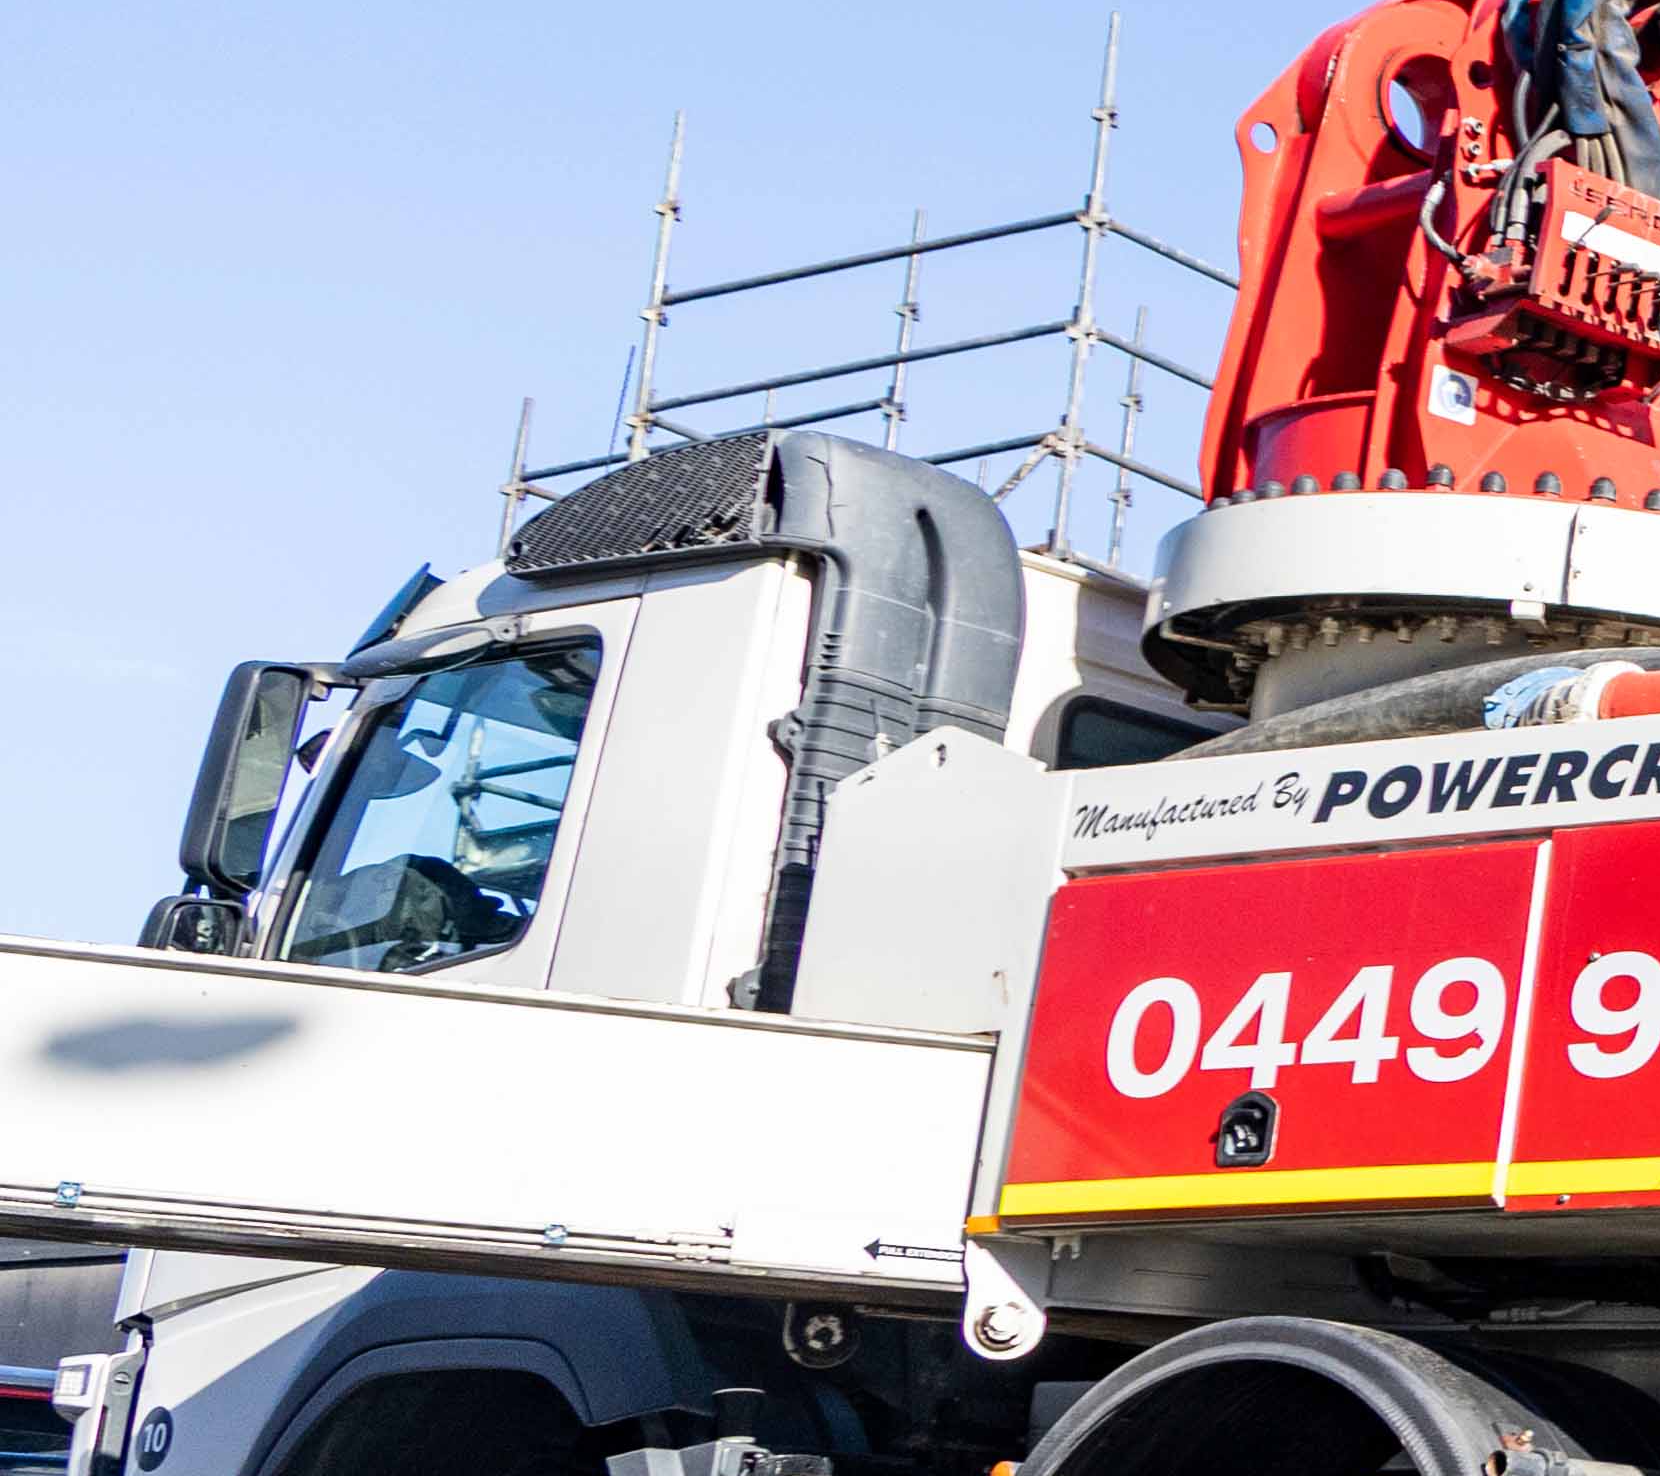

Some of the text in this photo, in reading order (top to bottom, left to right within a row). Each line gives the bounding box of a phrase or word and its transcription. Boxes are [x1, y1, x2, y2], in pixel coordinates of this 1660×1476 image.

[1073, 781, 1259, 840] Manufactured
[1273, 770, 1311, 817] By
[1105, 955, 1508, 1099] 0449
[142, 1423, 167, 1454] 10
